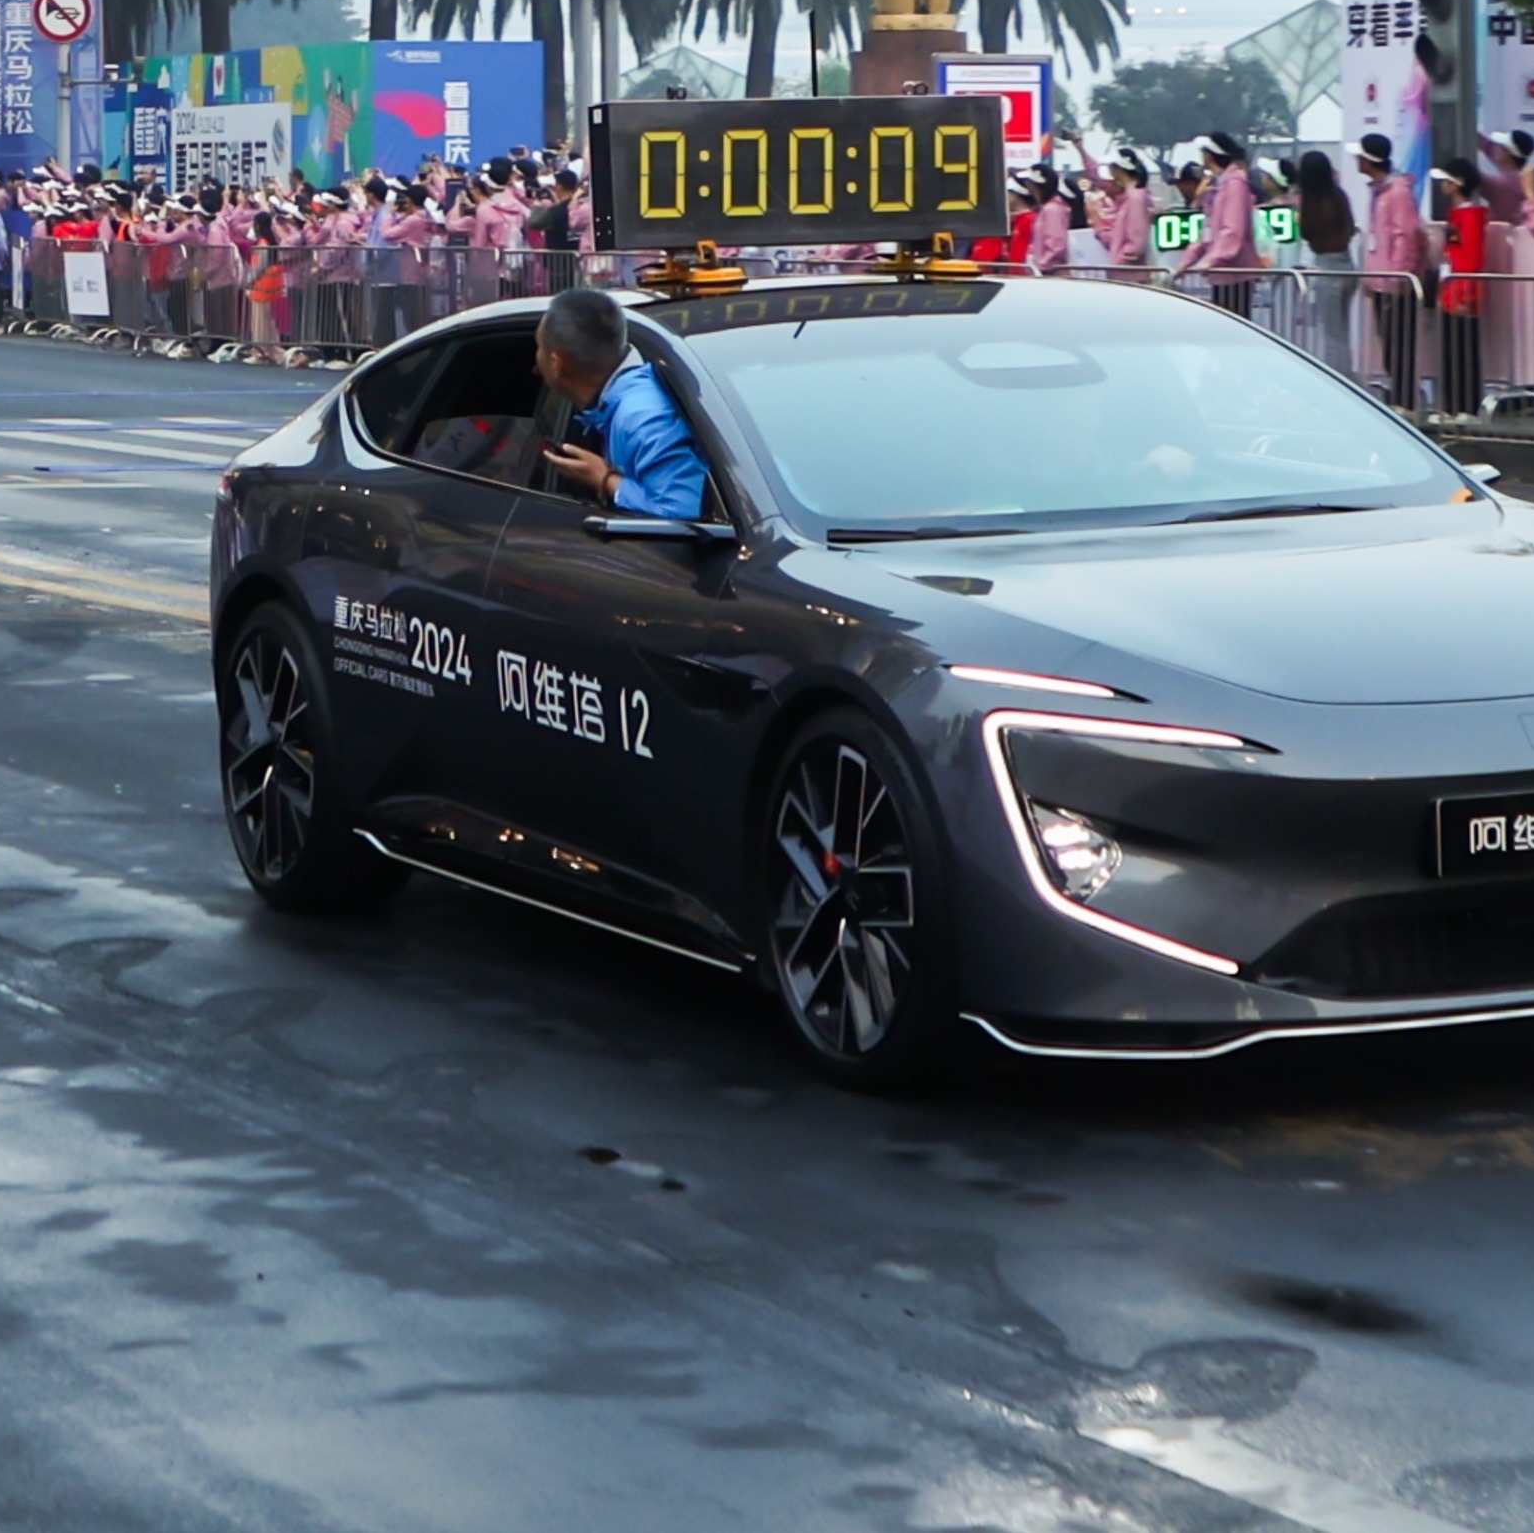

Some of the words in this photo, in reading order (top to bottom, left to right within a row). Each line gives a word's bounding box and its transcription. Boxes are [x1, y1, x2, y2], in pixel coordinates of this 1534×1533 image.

[639, 125, 979, 219] 0:00:09
[333, 595, 408, 645] 重庆马拉松
[409, 616, 473, 686] 2024
[496, 648, 606, 744] 阿维塔
[619, 686, 655, 759] 12
